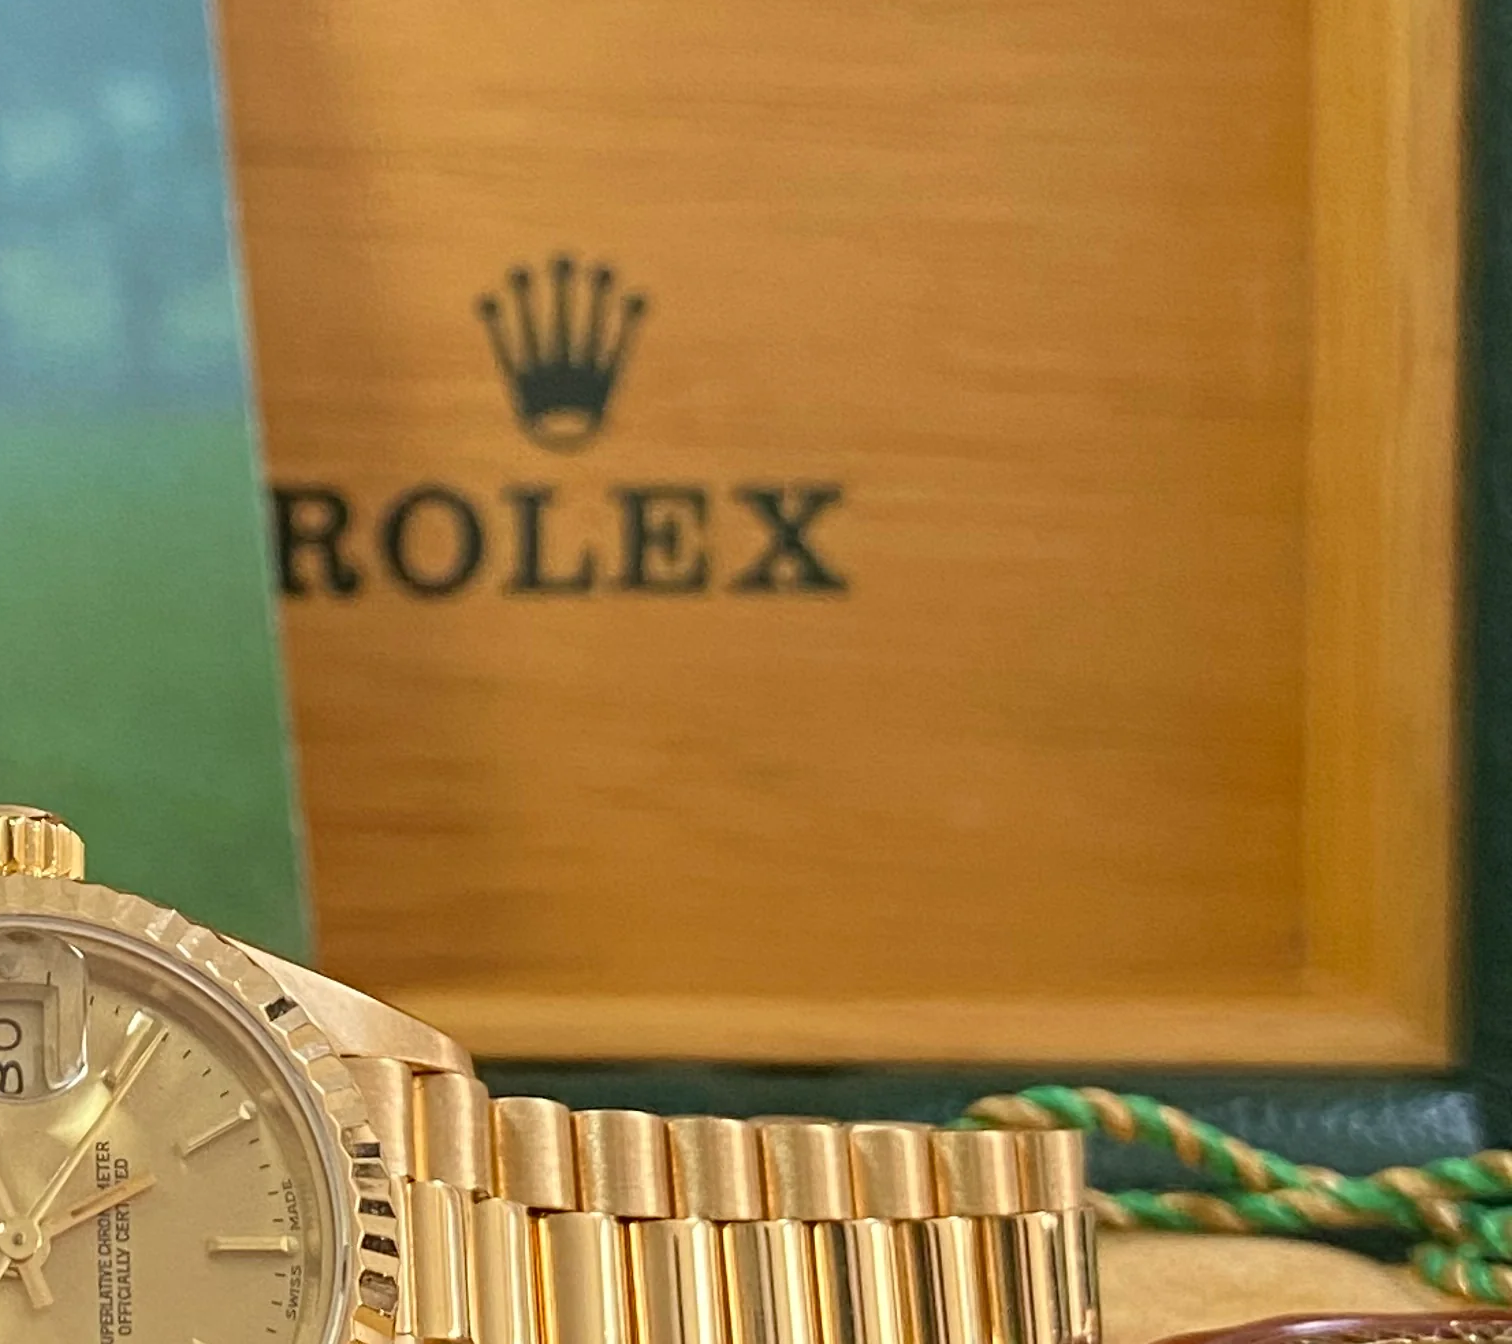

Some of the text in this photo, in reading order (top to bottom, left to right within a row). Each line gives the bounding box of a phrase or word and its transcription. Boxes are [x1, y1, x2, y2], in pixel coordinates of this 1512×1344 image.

[271, 483, 849, 599] ROLEX
[114, 1158, 133, 1337] OFFICIALLY CERTED
[282, 1178, 303, 1321] SWISS MADE
